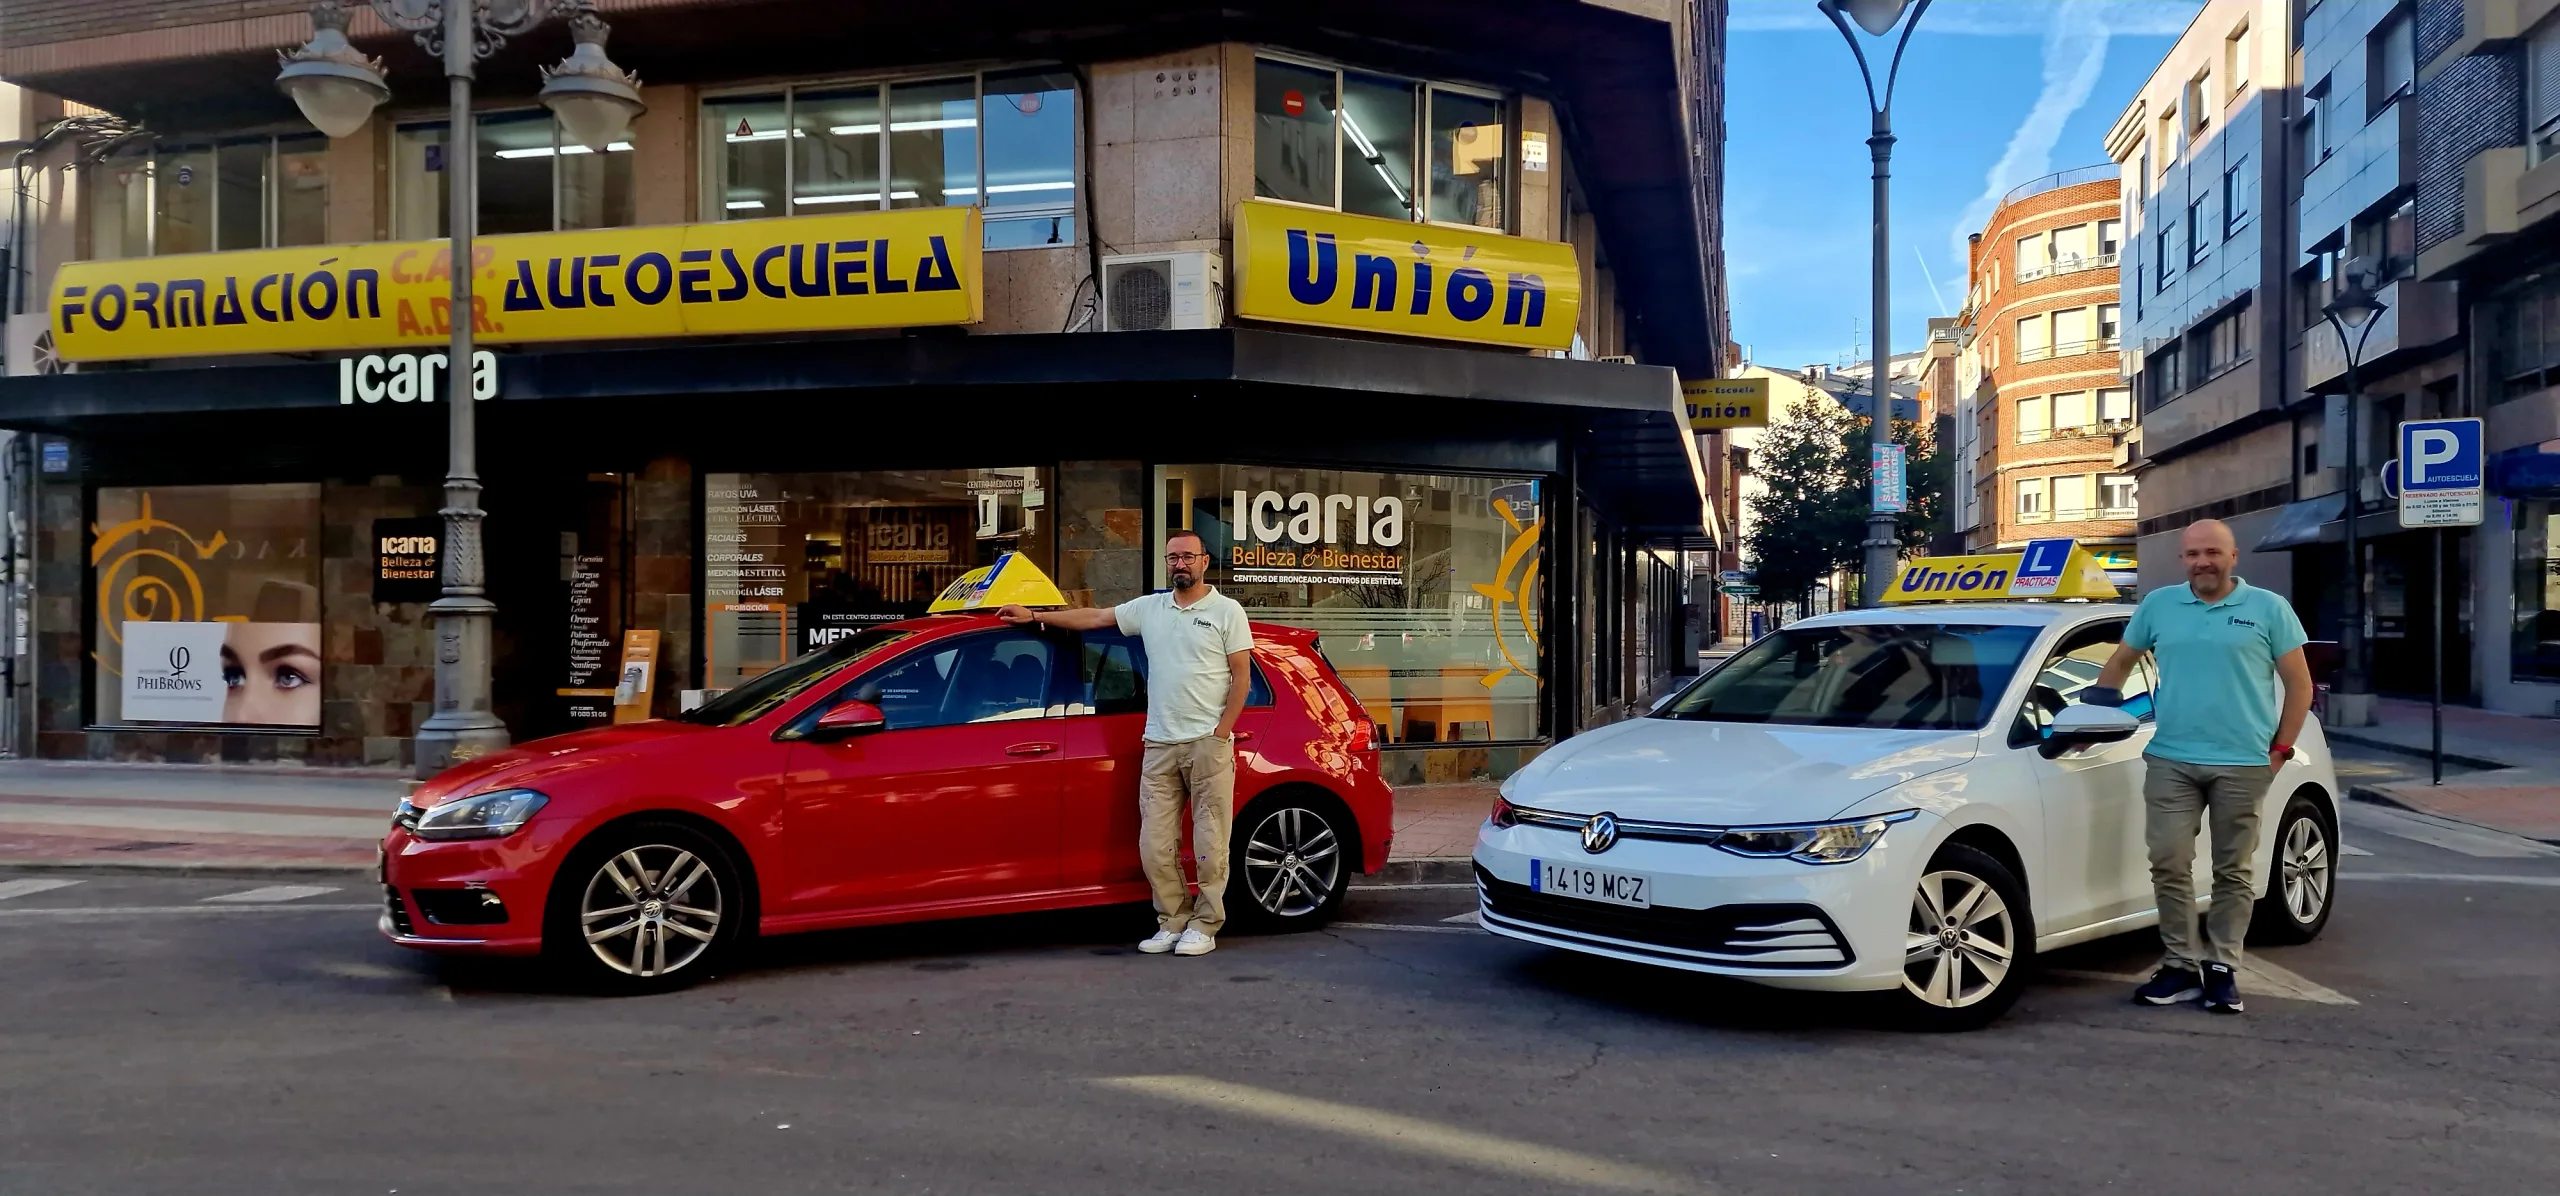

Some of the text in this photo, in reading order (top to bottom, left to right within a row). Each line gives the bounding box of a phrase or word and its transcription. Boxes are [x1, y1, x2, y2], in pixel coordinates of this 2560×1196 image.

[503, 235, 962, 312] AUTOESCUELA
[1286, 229, 1546, 327] Unión
[62, 257, 380, 334] FORMACIÓN
[1686, 402, 1751, 419] Unión
[2411, 429, 2460, 484] P
[2427, 474, 2479, 483] AUTOESCUELA
[740, 490, 758, 499] UVA
[707, 534, 748, 542] FACIALES
[382, 557, 421, 567] Belleza
[707, 554, 763, 562] CORPORALES
[1232, 546, 1296, 567] Belleza
[1323, 548, 1403, 569] Bienestar
[2029, 546, 2052, 572] L
[382, 568, 435, 579] Bienestar
[708, 569, 786, 577] MEDICINA ESTETICA
[1901, 563, 2008, 593] Unión
[1233, 574, 1403, 585] CENTROS DE BRONCEADO CENTROS DE ESTÉTICA
[754, 585, 783, 596] LÁSER
[725, 604, 769, 612] PROMOCIÓN
[571, 614, 599, 623] Orense
[1548, 866, 1644, 903] 1419 MCZ
